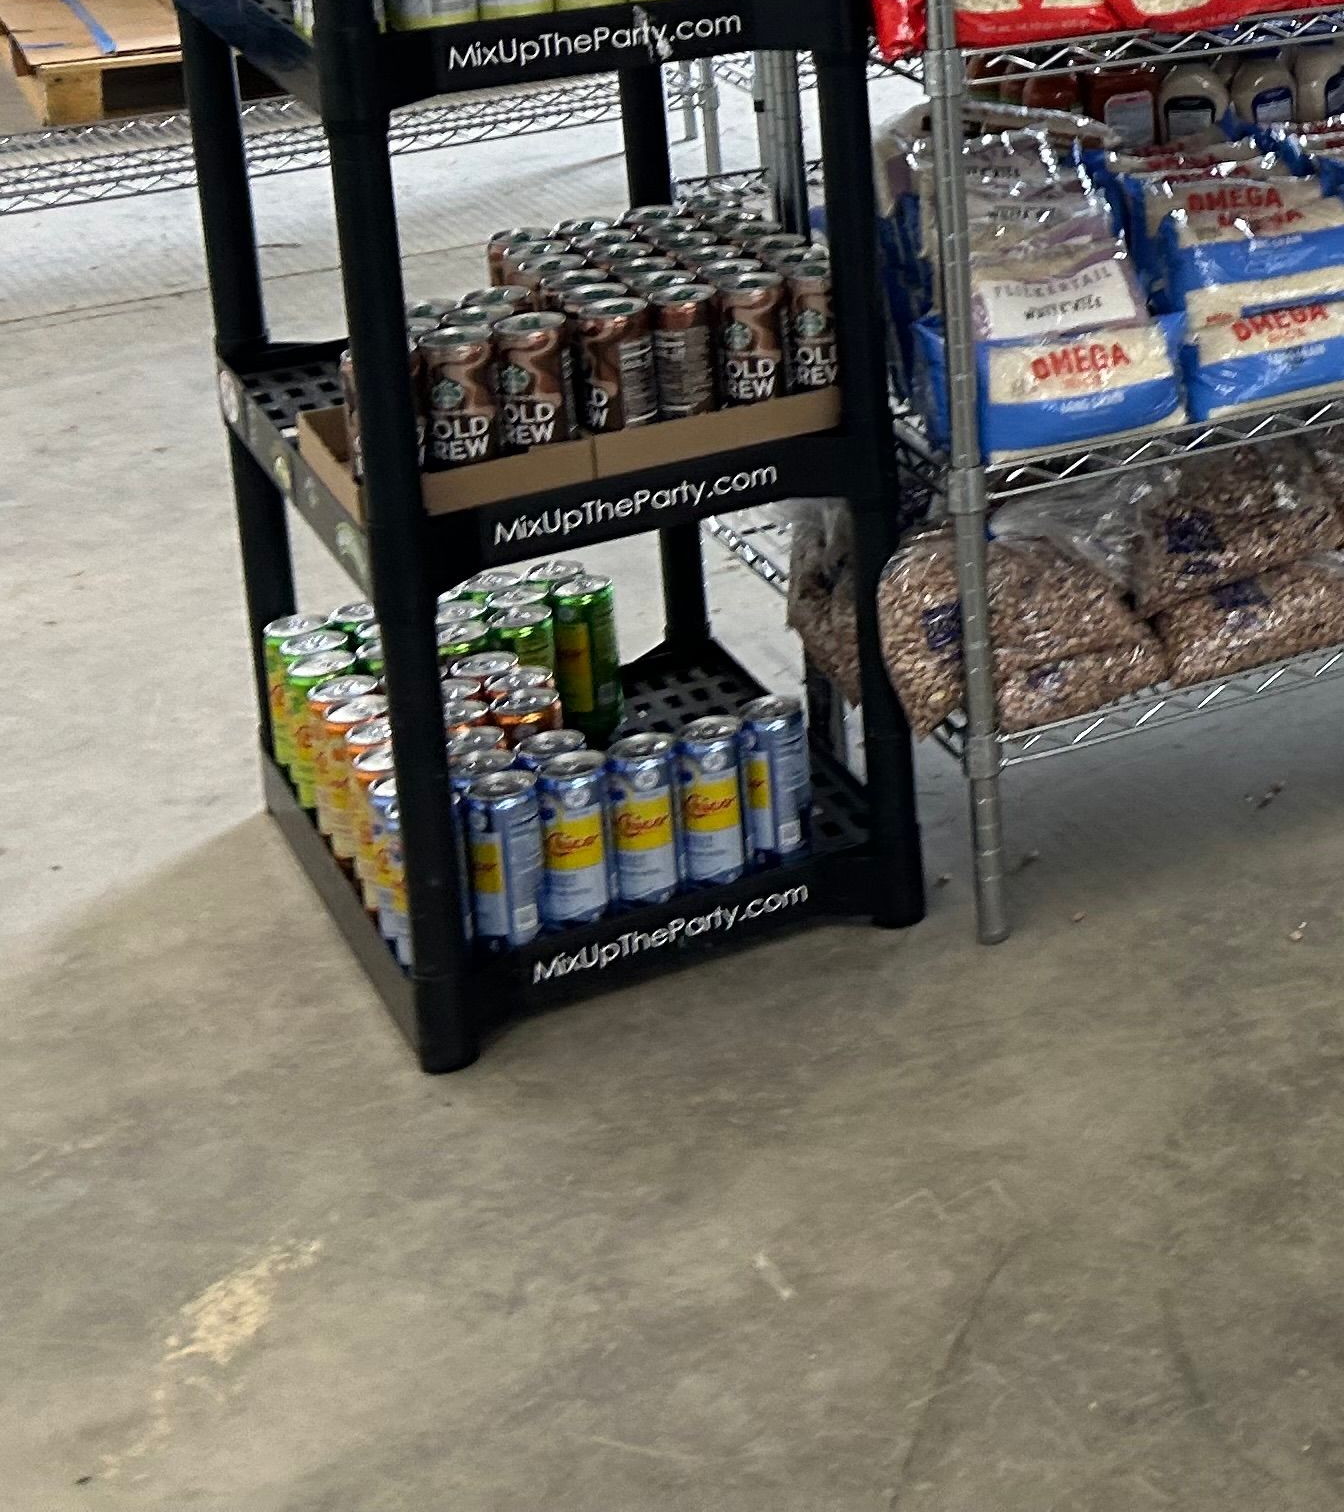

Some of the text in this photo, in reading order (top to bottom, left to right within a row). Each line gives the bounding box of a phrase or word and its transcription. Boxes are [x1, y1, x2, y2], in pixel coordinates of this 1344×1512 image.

[449, 13, 742, 70] MixUpTheParty.com
[1187, 186, 1284, 212] OMEGA
[1231, 303, 1330, 342] OMEGA
[725, 357, 776, 378] OLD
[1031, 342, 1131, 381] OMEGA
[728, 376, 776, 400] REW
[433, 414, 490, 439] OLD
[503, 402, 556, 424] OLD
[432, 434, 490, 461] REW
[493, 464, 778, 546] MixUpTheParty.com
[532, 882, 810, 986] MixUpTheParty.com
